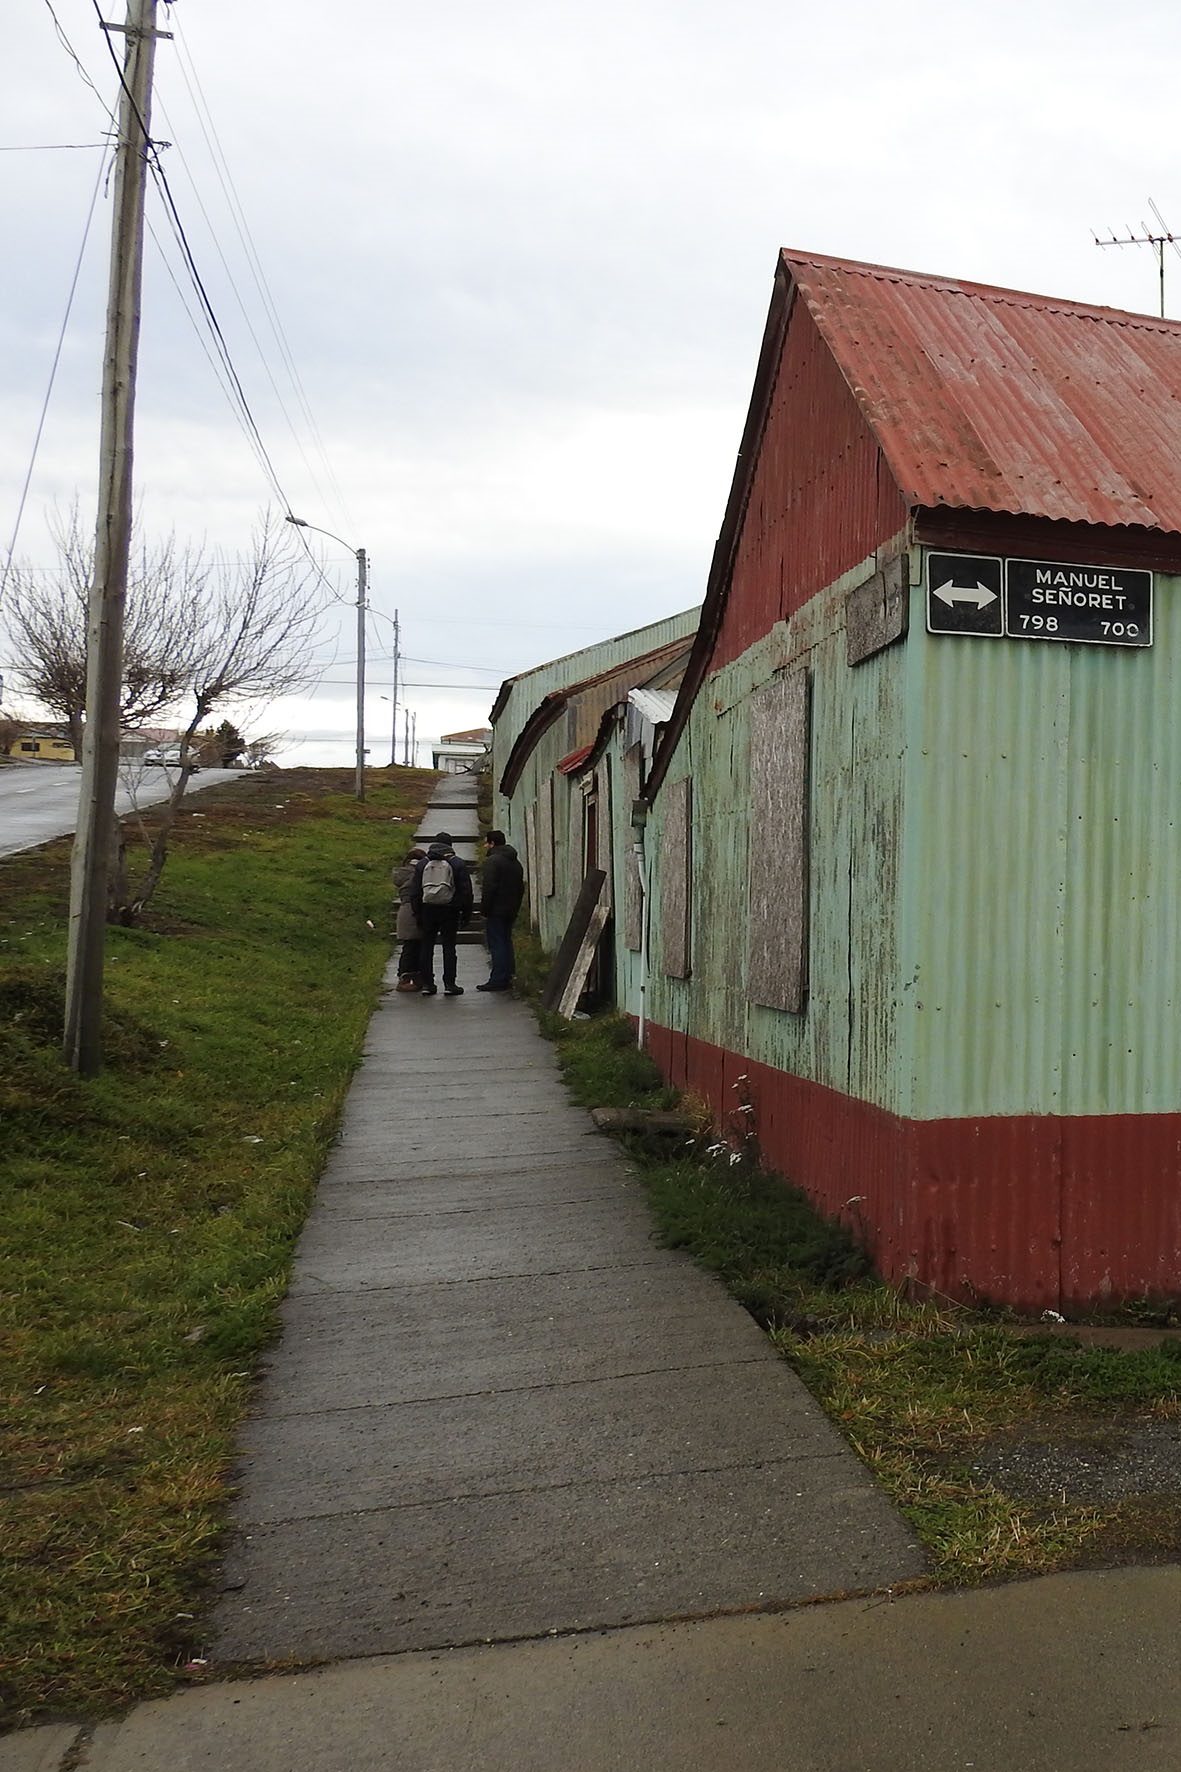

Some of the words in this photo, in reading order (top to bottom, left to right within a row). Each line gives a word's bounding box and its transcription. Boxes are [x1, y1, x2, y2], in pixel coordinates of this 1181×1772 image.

[1036, 569, 1123, 590] MANUEL
[1032, 587, 1127, 610] SEÑORET
[1019, 614, 1059, 632] 798
[1100, 621, 1140, 637] 700
